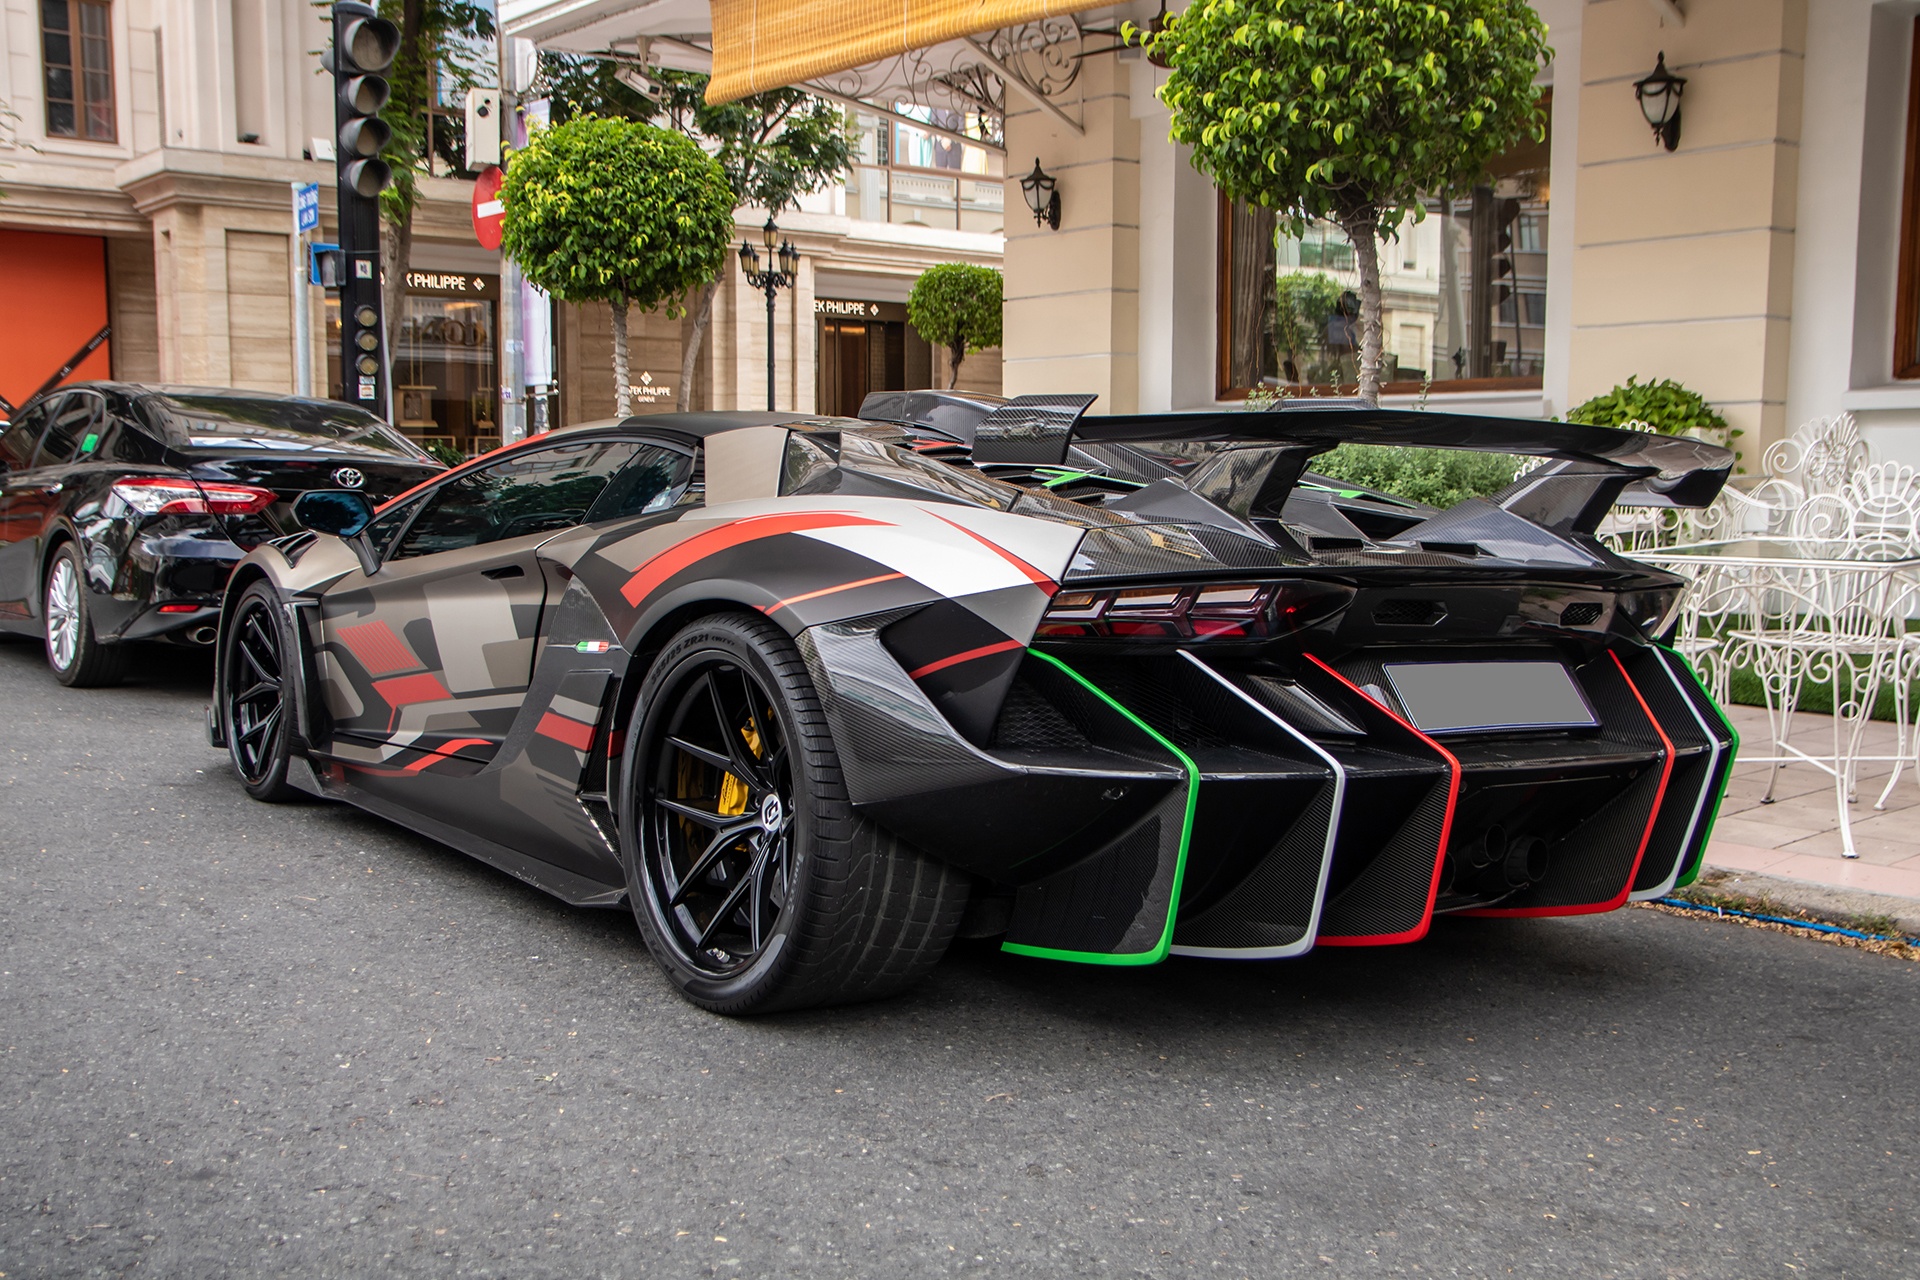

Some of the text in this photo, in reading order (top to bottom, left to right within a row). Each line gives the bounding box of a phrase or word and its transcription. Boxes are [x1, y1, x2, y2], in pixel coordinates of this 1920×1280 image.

[413, 272, 466, 291] PHILIPPE
[826, 300, 865, 316] PHILIPPE
[683, 633, 710, 650] ZR21
